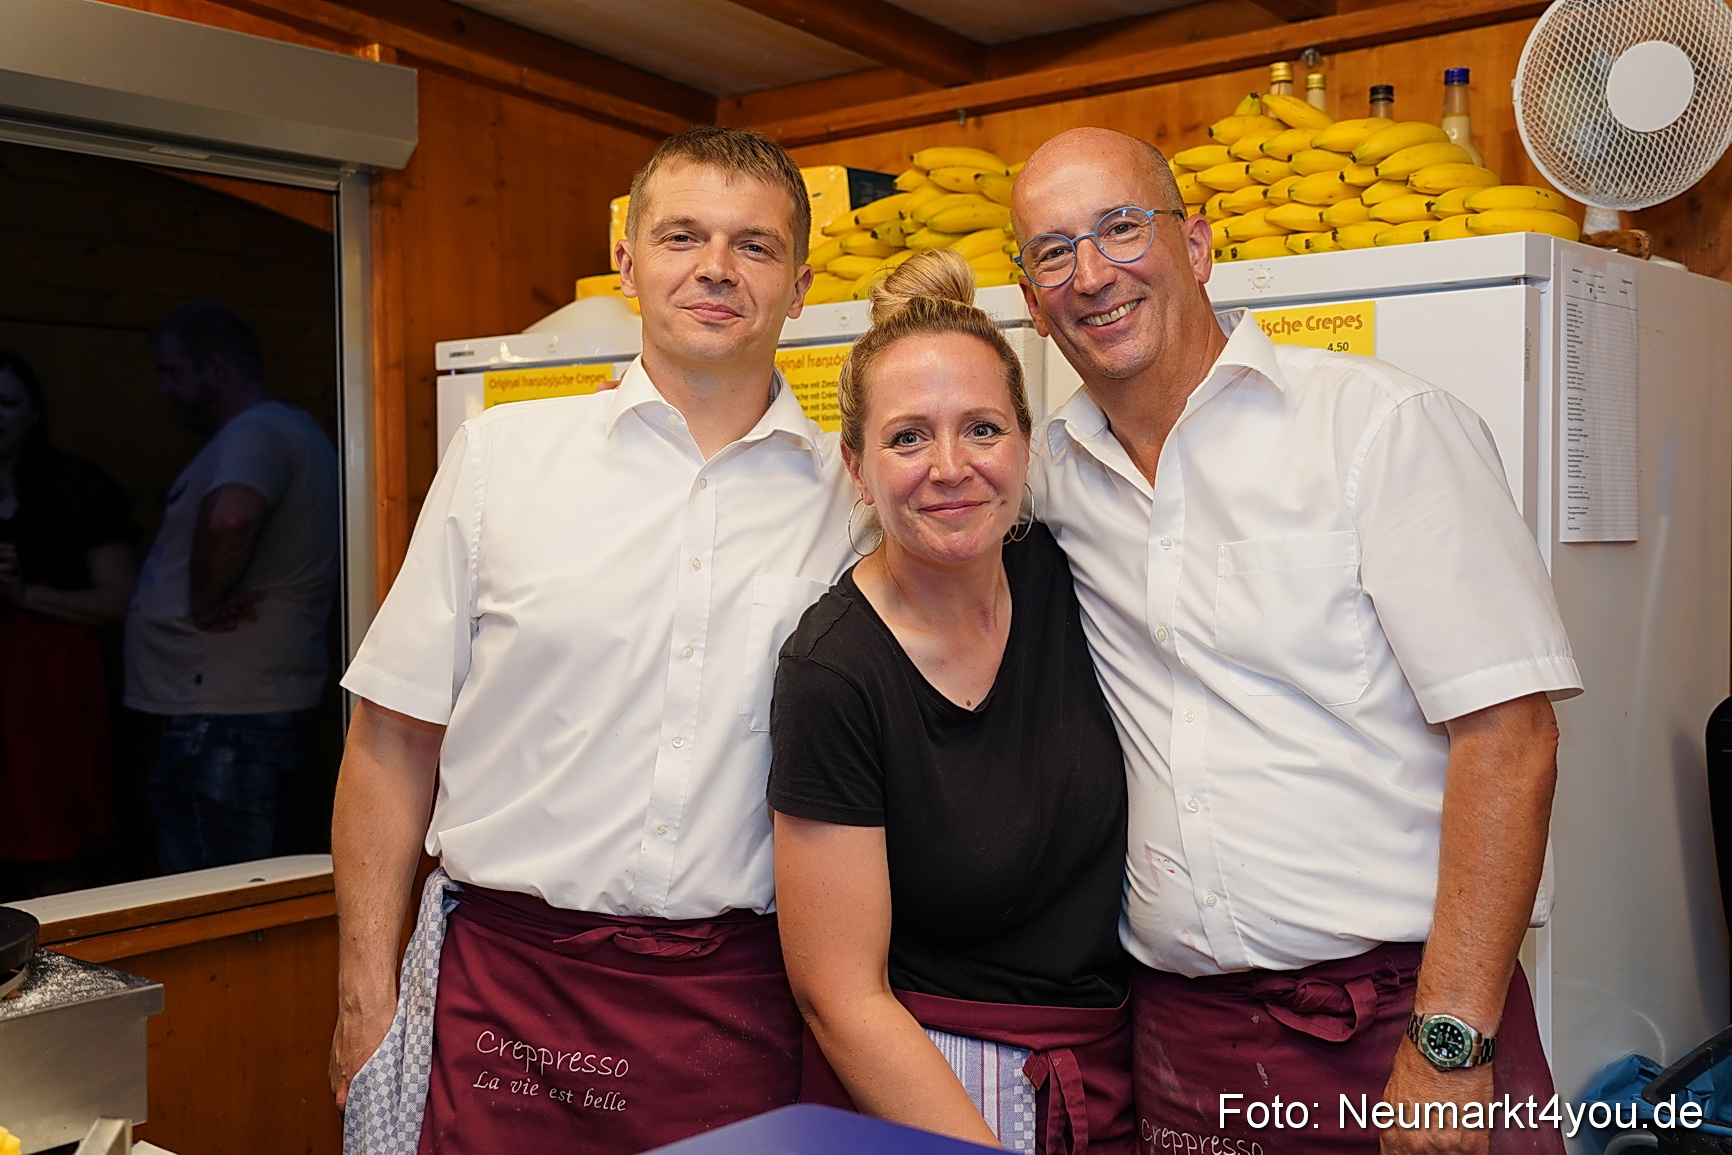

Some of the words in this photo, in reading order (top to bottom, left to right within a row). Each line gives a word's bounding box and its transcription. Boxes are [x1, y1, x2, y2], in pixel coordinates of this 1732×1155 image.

[1258, 316, 1303, 337] ische
[1305, 313, 1363, 334] Crepes
[1327, 341, 1349, 353] 4.50
[488, 377, 520, 393] Original
[575, 372, 607, 387] Crepes
[476, 1030, 629, 1078] Creppresso
[473, 1071, 500, 1090] La
[510, 1077, 540, 1097] vie
[549, 1087, 574, 1104] est
[583, 1087, 627, 1112] belle
